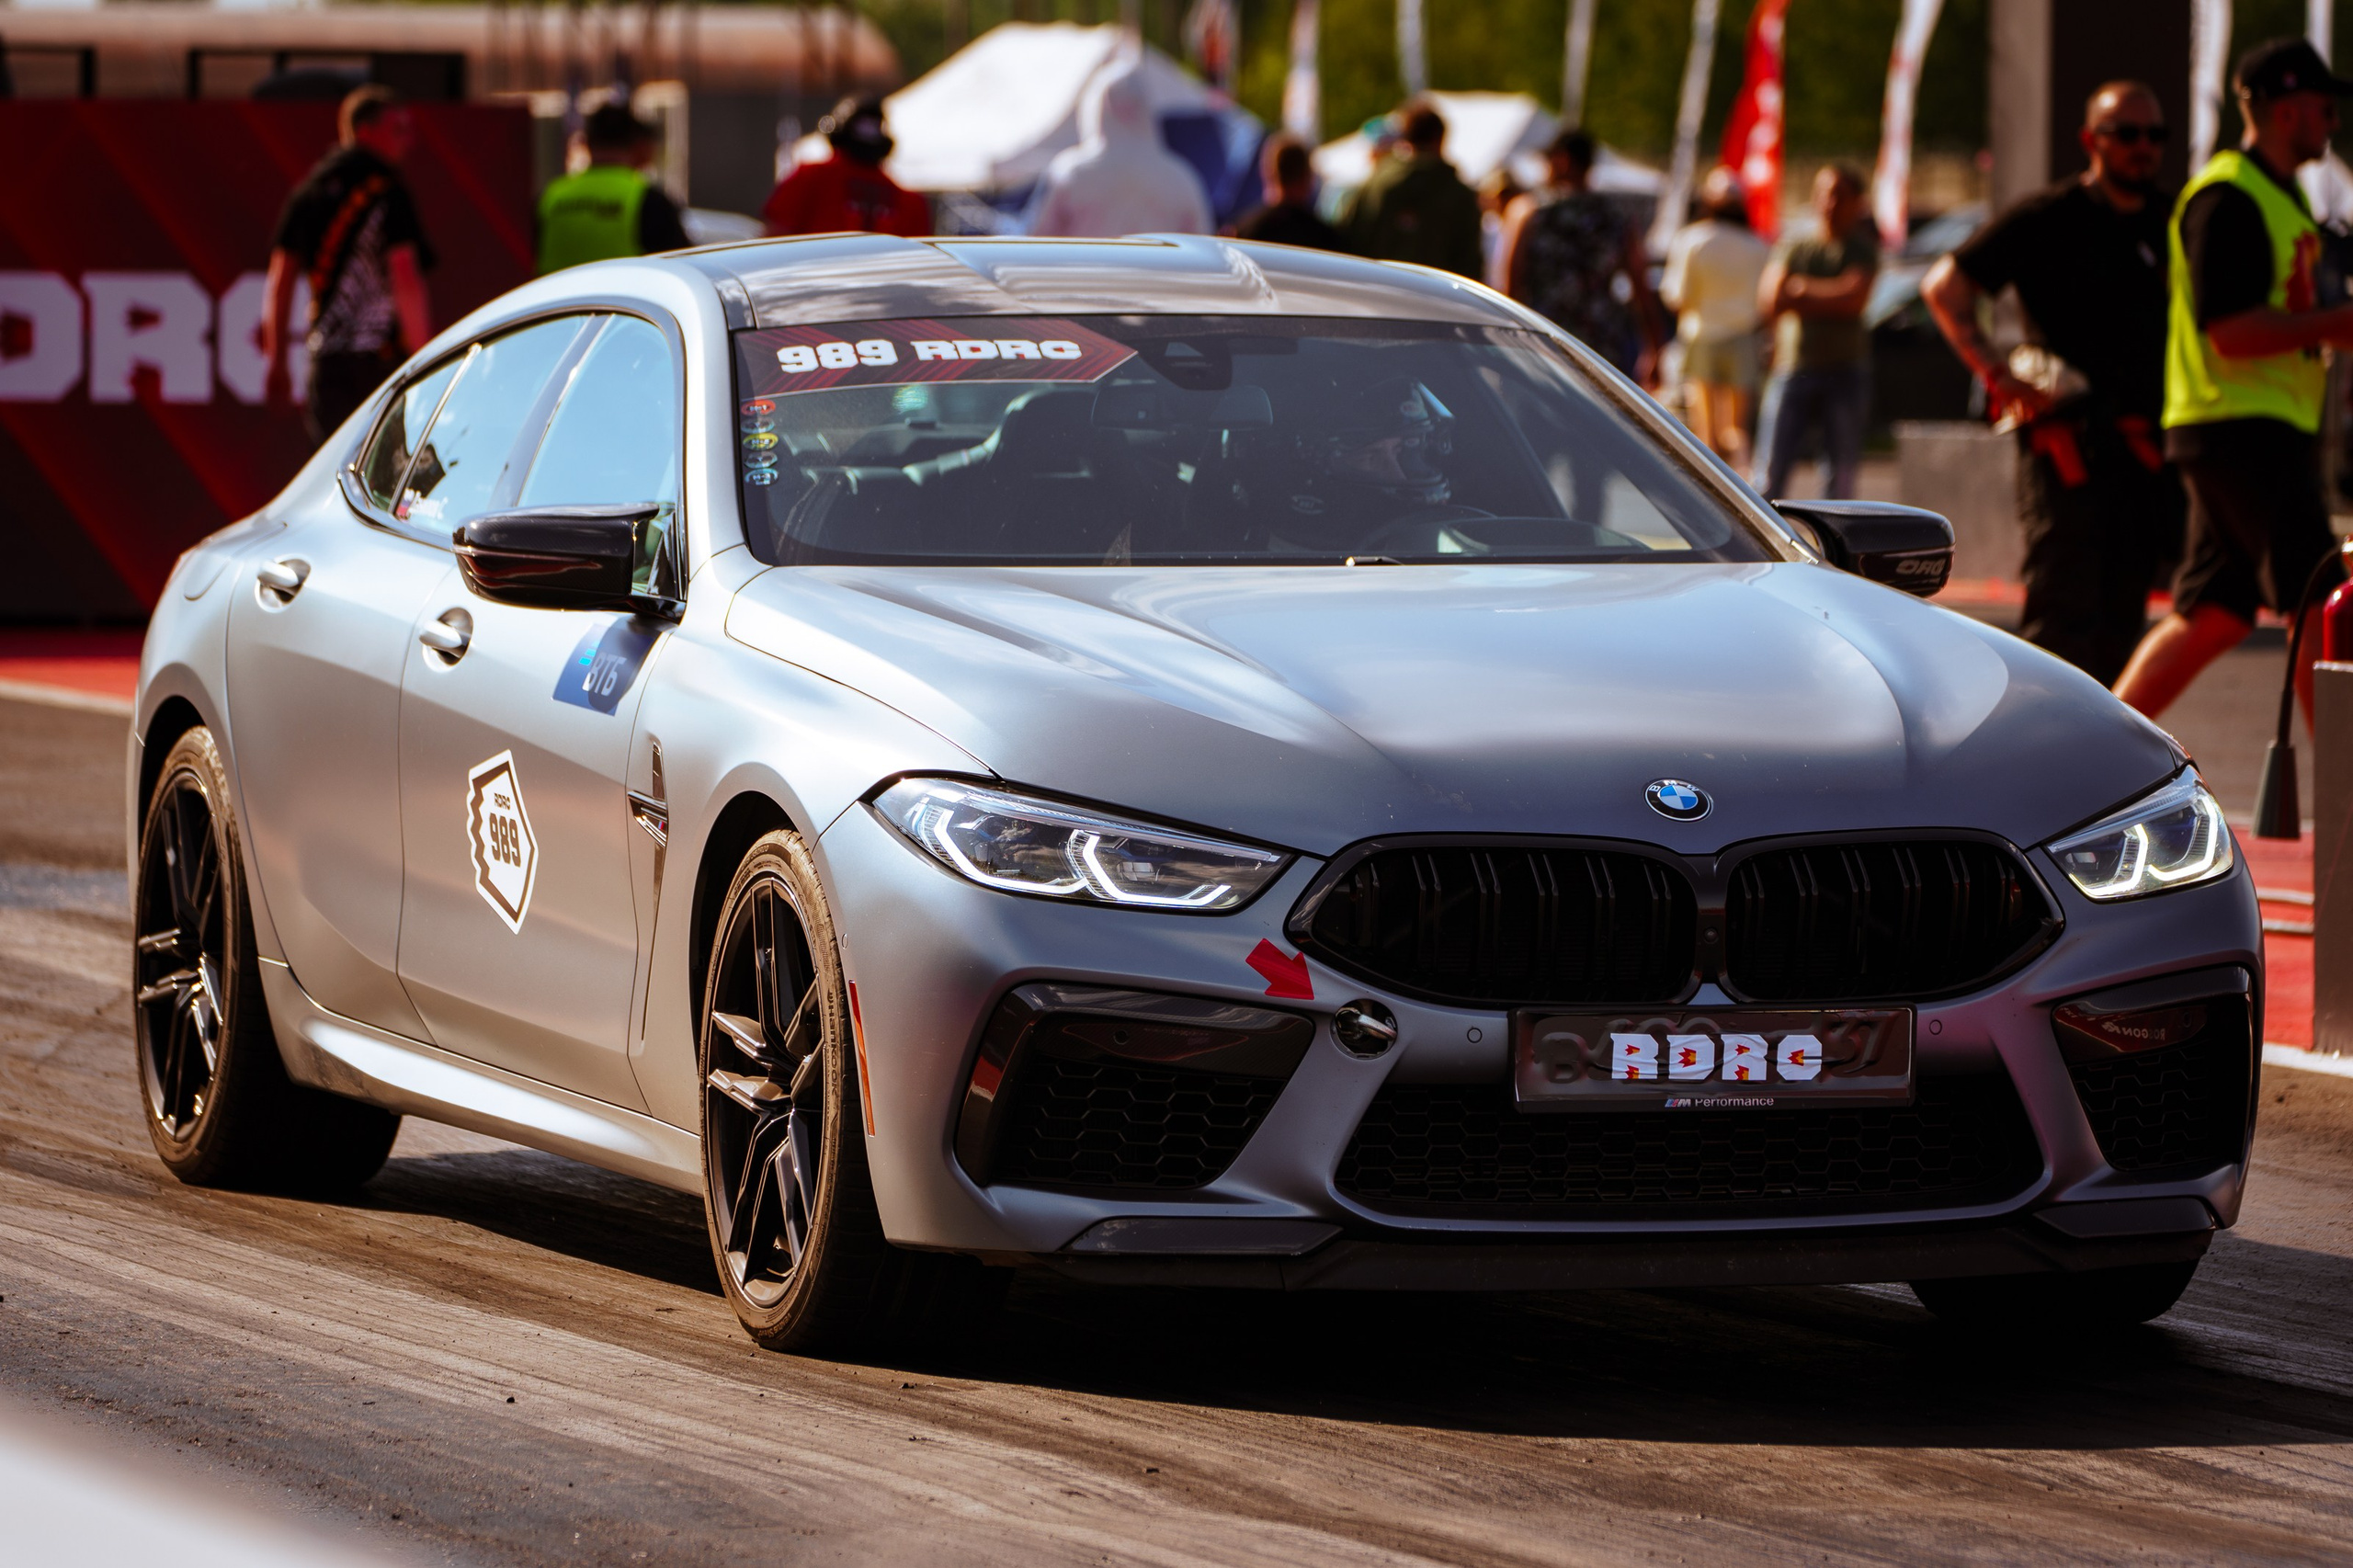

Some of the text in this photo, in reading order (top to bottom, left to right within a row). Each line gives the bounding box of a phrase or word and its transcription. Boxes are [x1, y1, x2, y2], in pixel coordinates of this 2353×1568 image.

[777, 339, 1083, 373] 989 RDRC
[582, 651, 627, 697] ВТБ
[494, 792, 511, 811] RDRC
[1648, 779, 1699, 792] BMW
[489, 812, 521, 868] 989
[1610, 1032, 1823, 1081] RDRC
[1695, 1097, 1775, 1108] Performance
